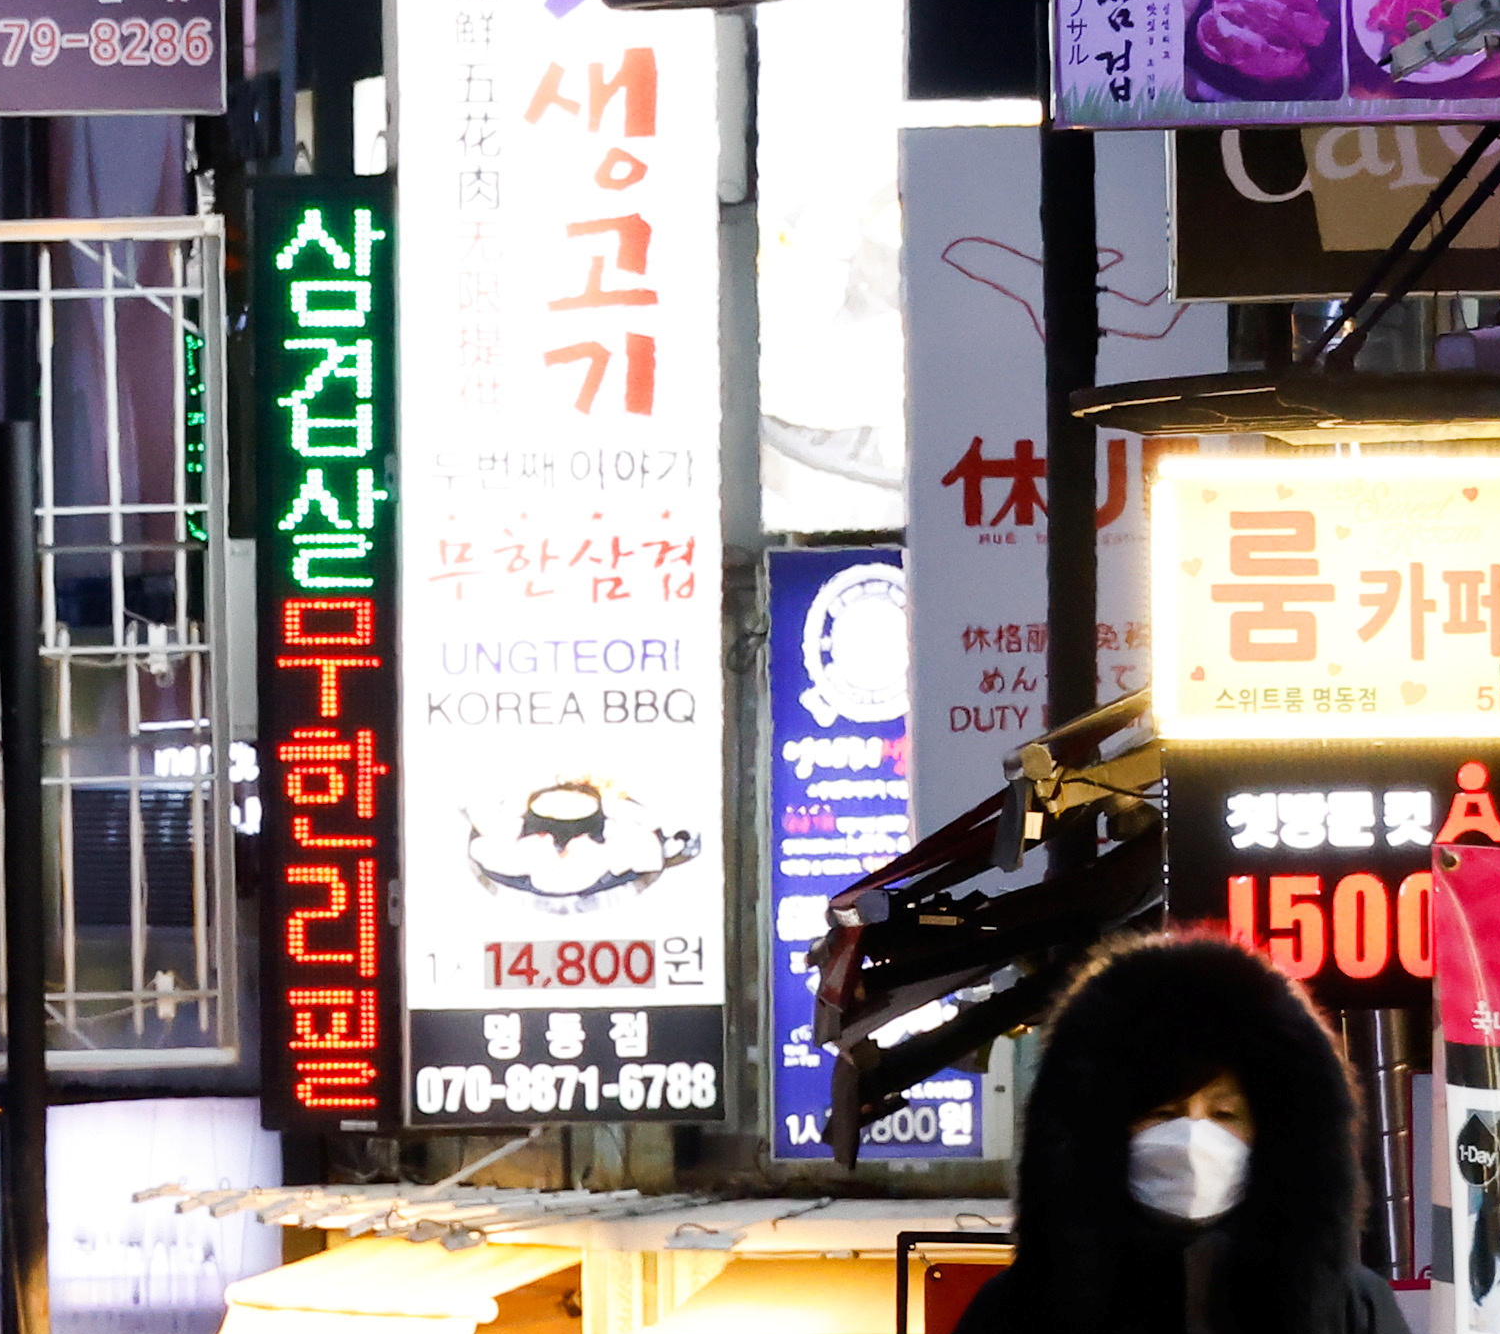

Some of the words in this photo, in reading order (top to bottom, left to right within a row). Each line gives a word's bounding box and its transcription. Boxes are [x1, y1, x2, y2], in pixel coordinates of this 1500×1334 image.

[523, 45, 660, 417] 생고기
[276, 207, 387, 589] 삼겹살
[432, 448, 558, 492] 두번째
[569, 448, 695, 491] 이야기
[428, 526, 701, 604] 무한삼겹
[1209, 510, 1336, 663] 룸
[441, 637, 684, 676] UNGTEORI
[425, 689, 584, 727] KOREA
[602, 687, 698, 726] BBQ
[948, 704, 1029, 733] DUTY
[1214, 685, 1307, 714] 스위트룸
[1312, 684, 1379, 713] 명동점
[277, 598, 388, 1111] 무한리필
[415, 1063, 718, 1115] 070-8871-6788
[1457, 1145, 1498, 1167] 1-Day
